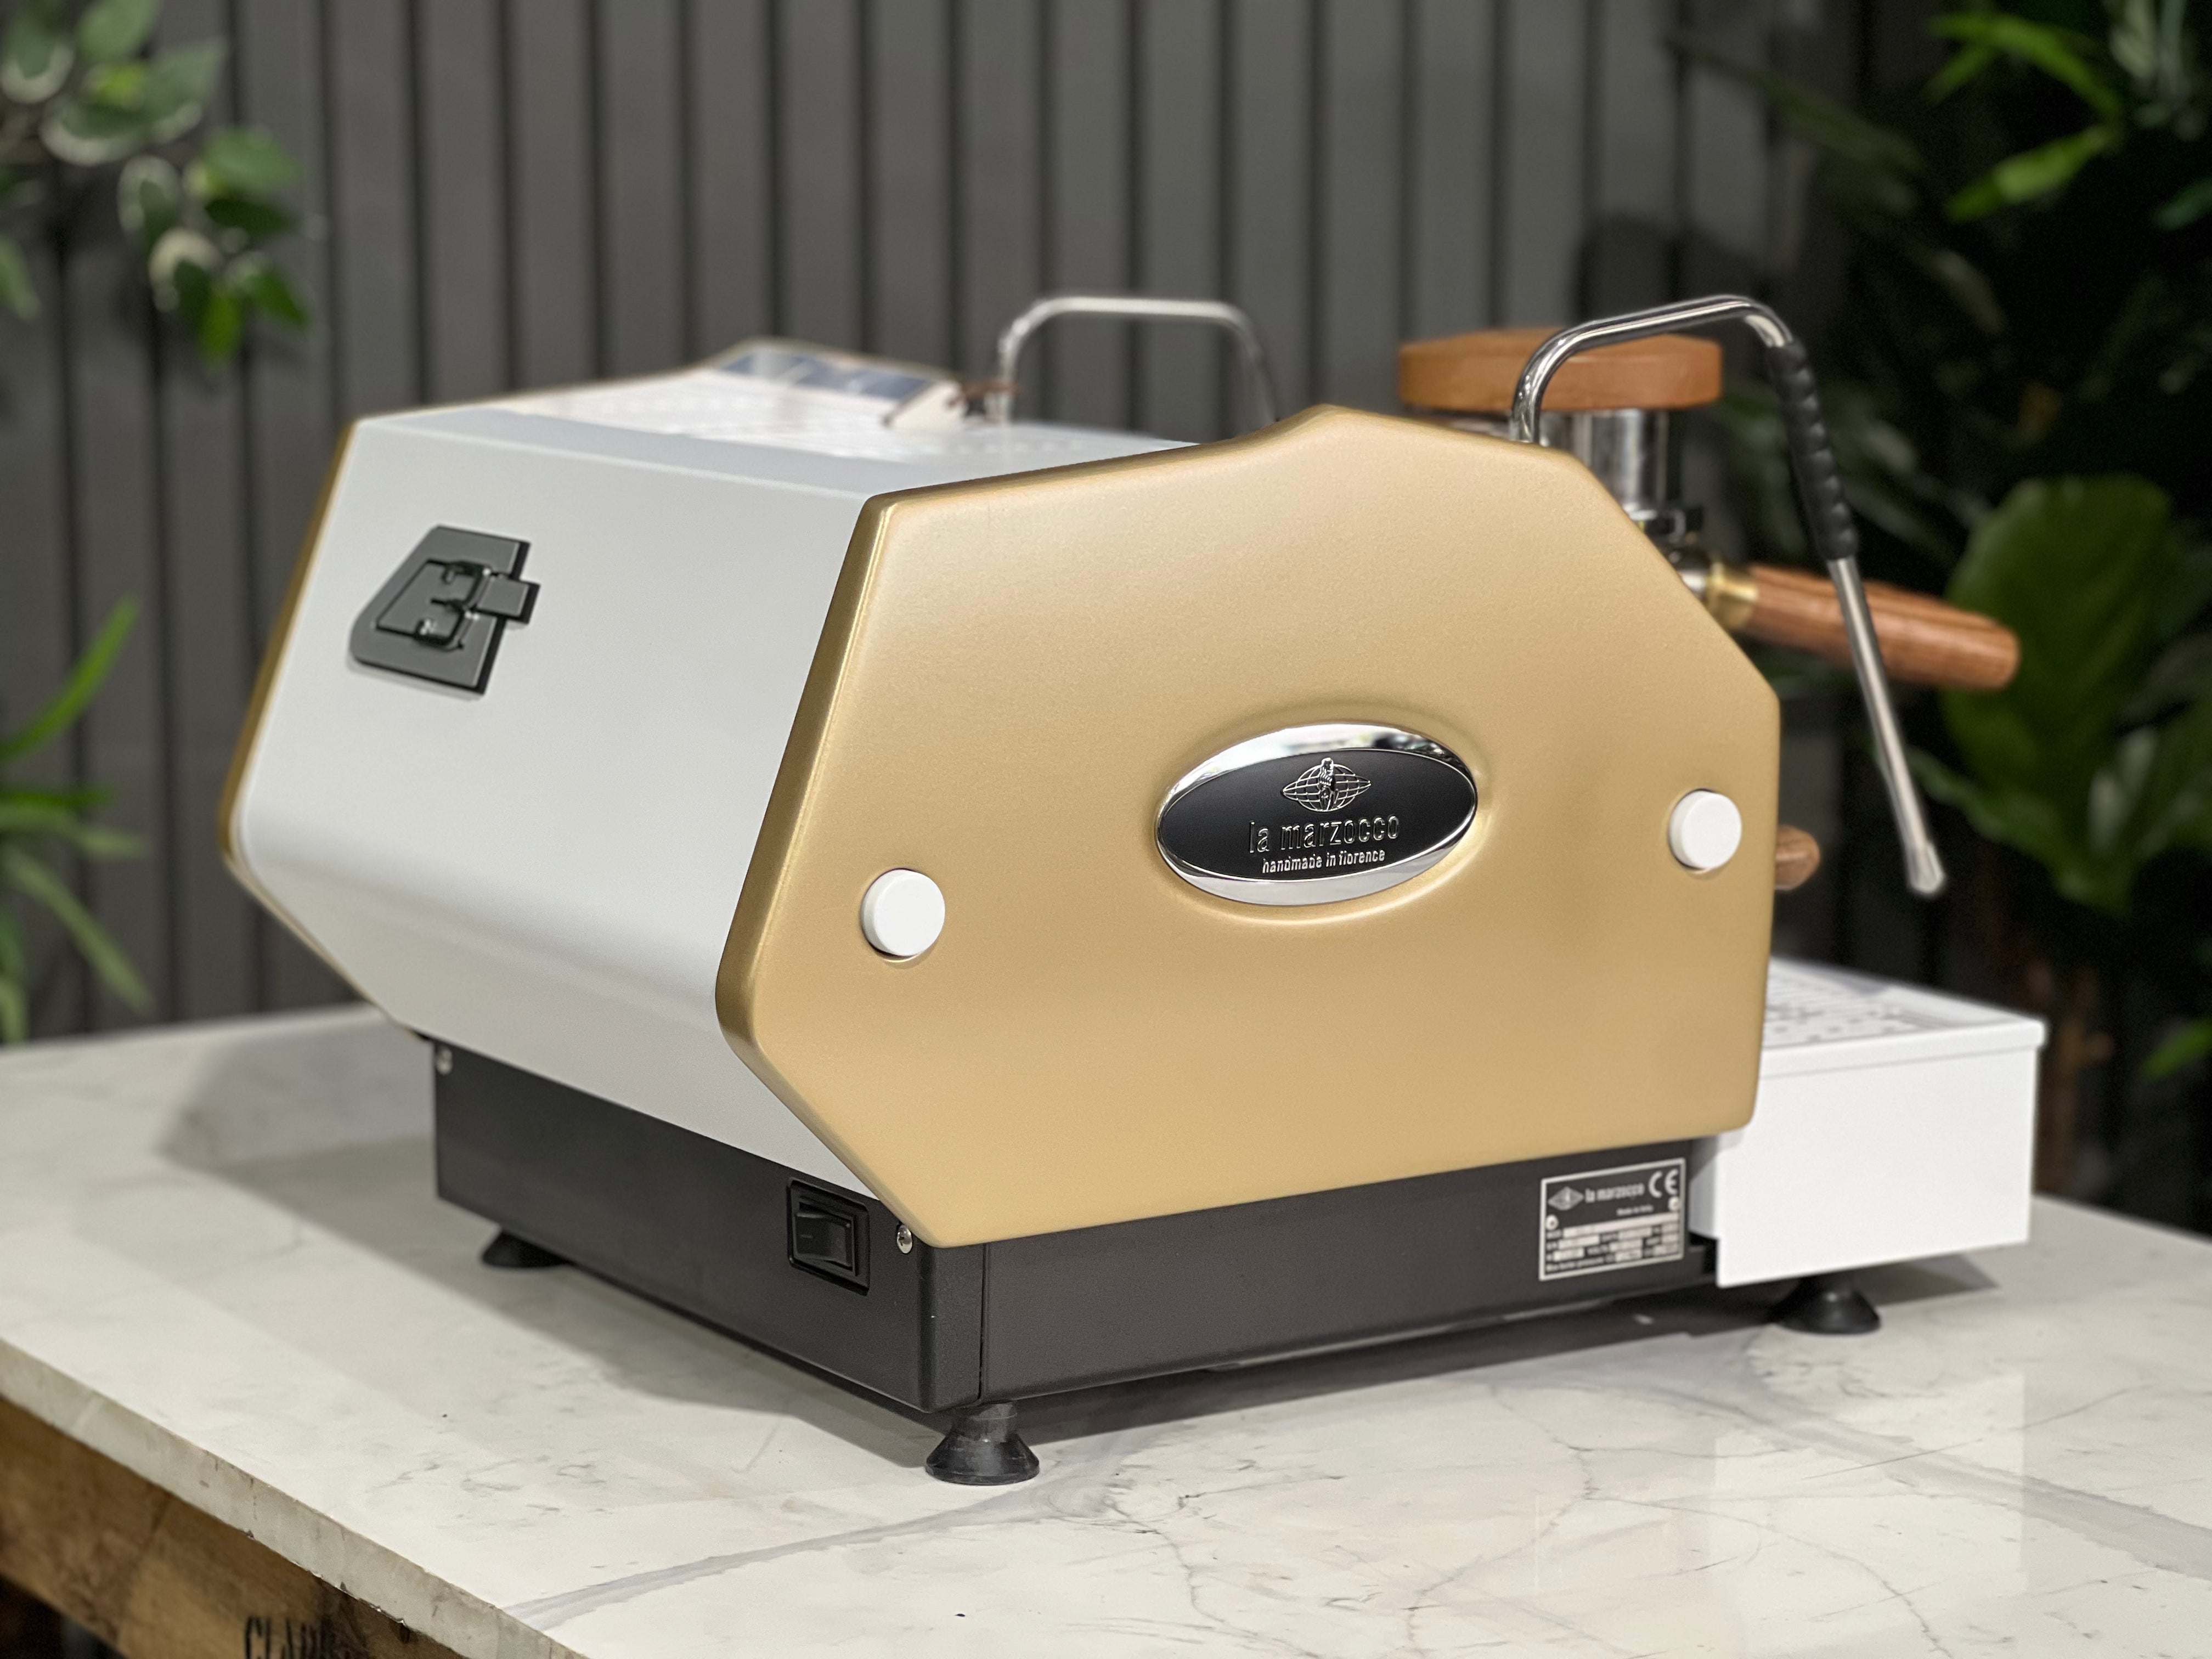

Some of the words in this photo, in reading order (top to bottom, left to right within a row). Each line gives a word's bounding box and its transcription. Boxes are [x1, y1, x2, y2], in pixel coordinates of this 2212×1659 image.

[1249, 820, 1269, 854] la
[1280, 815, 1399, 851] marzocco
[1262, 854, 1322, 874] handmade
[1325, 852, 1336, 867] in
[1339, 849, 1386, 866] florence
